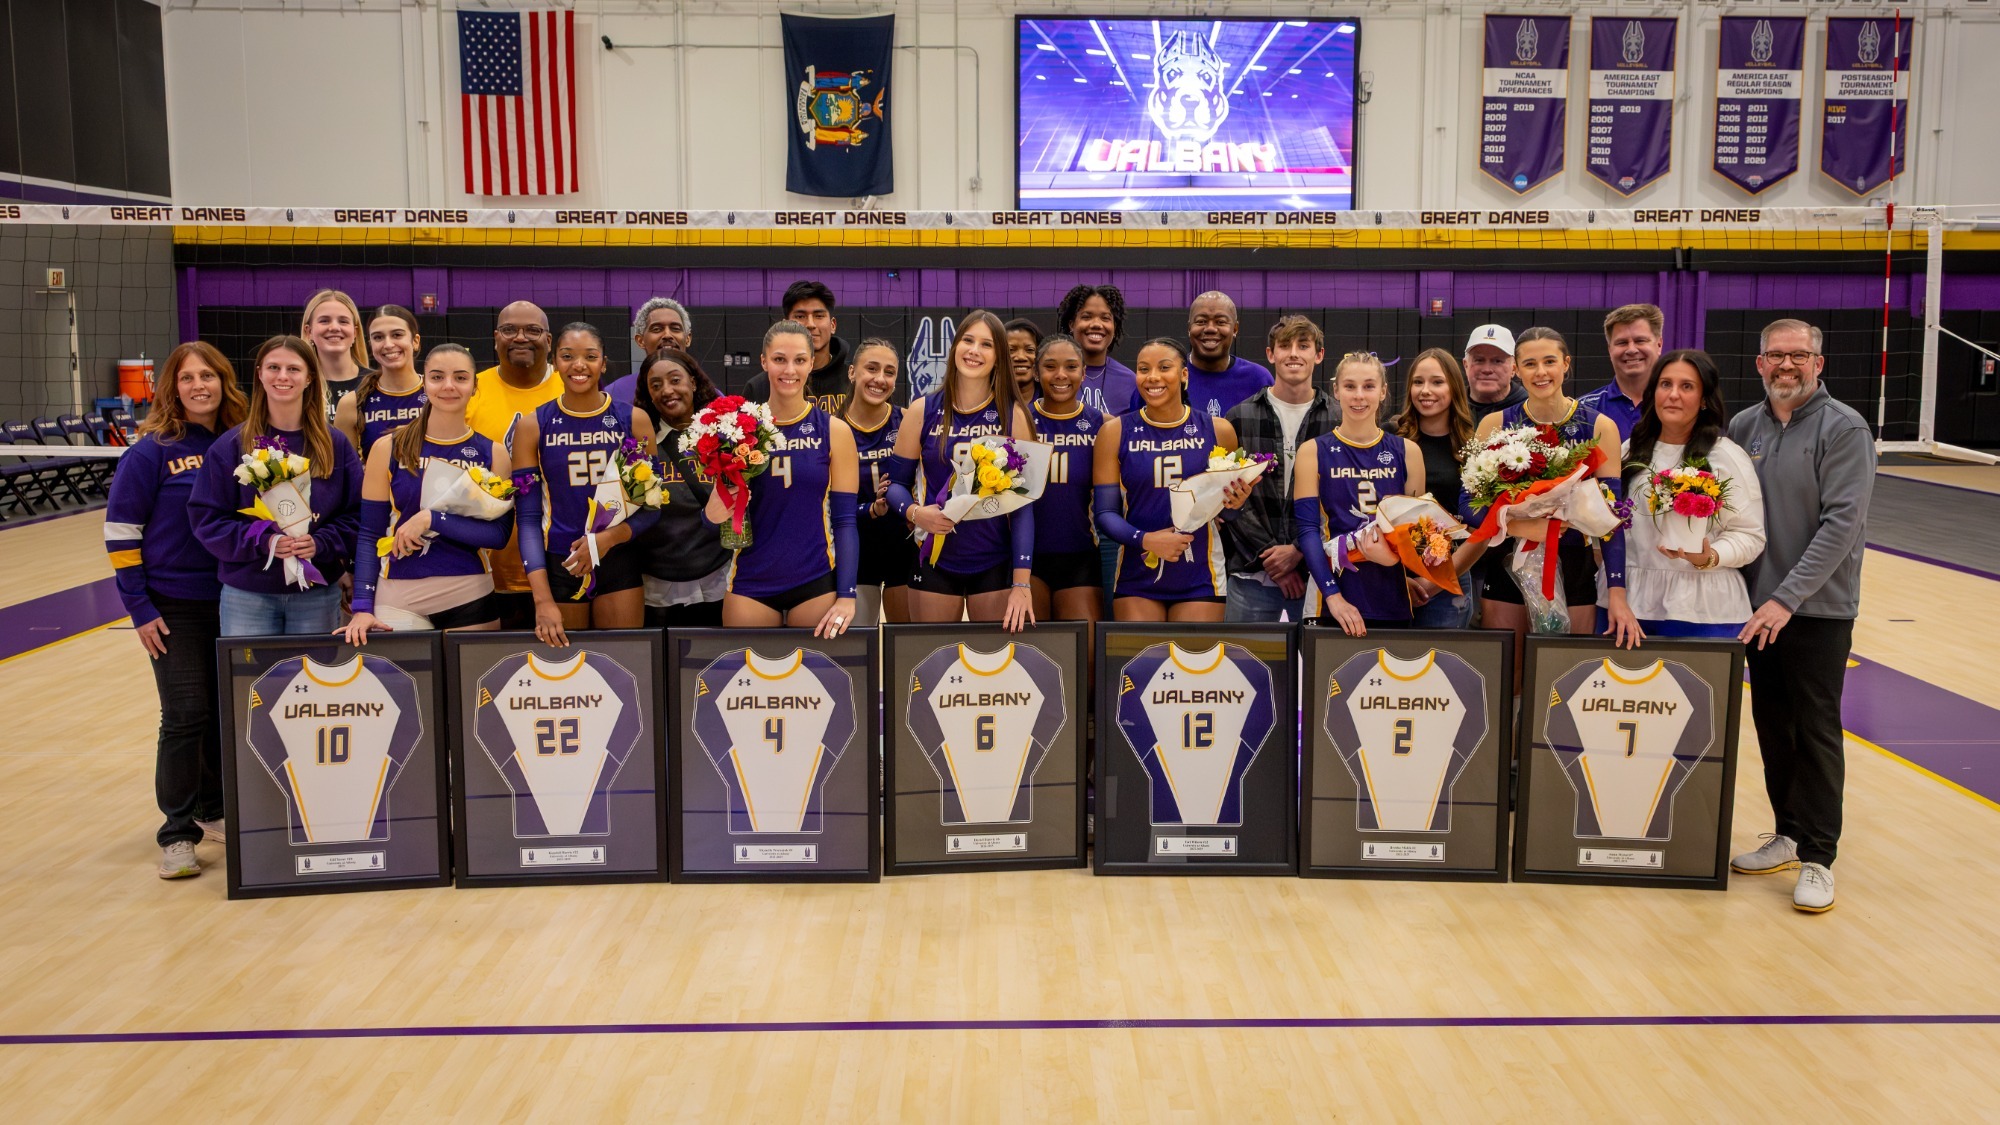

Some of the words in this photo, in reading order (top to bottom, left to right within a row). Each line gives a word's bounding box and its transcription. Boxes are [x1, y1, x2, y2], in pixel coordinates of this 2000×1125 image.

[1485, 103, 1507, 111] 2004
[1592, 105, 1614, 113] 2004
[1720, 104, 1741, 112] 2004
[1747, 104, 1768, 112] 2011
[1747, 115, 1768, 123] 2012
[1485, 124, 1506, 132] 2007
[1591, 126, 1612, 134] 2007
[1718, 125, 1740, 133] 2006
[1746, 125, 1768, 133] 2015
[1746, 136, 1766, 144] 2017
[1085, 139, 1278, 172] UALBANY
[1591, 147, 1611, 155] 2010
[1717, 146, 1739, 154] 2009
[1745, 146, 1766, 154] 2019
[111, 207, 172, 221] GREAT
[182, 207, 245, 221] DANES
[335, 209, 396, 223] GREAT
[405, 210, 467, 223] DANES
[556, 211, 617, 224] GREAT
[626, 211, 687, 225] DANES
[775, 211, 836, 225] GREAT
[845, 212, 906, 225] DANES
[993, 211, 1052, 225] GREAT
[1061, 211, 1121, 225] DANES
[1208, 211, 1267, 225] GREAT
[1275, 211, 1336, 225] DANES
[1421, 211, 1481, 224] GREAT
[1489, 211, 1549, 224] DANES
[1634, 209, 1693, 223] GREAT
[1701, 209, 1760, 222] DANES
[364, 407, 422, 423] UALBA
[546, 431, 625, 447] UALBANY
[1036, 433, 1097, 446] ALBANY
[1128, 438, 1205, 452] UALBANY
[568, 450, 608, 487] 22
[772, 456, 792, 488] 4
[1050, 451, 1068, 484] 11
[1154, 455, 1182, 488] 12
[1330, 467, 1397, 480] UALBANY
[1358, 481, 1378, 514] 2
[509, 694, 603, 711] UALBANY
[726, 695, 822, 711] UALBANY
[939, 692, 1031, 709] UALBANY
[1152, 689, 1245, 705] UALBANY
[1360, 695, 1450, 712] UALBANY
[284, 702, 384, 719] UALBANY
[1582, 698, 1677, 716] UALBANY
[534, 716, 581, 756] 22
[763, 716, 785, 755] 4
[974, 713, 996, 752] 6
[1181, 710, 1215, 750] 12
[1392, 717, 1415, 756] 2
[316, 724, 352, 766] 10
[1616, 720, 1639, 758] 7
